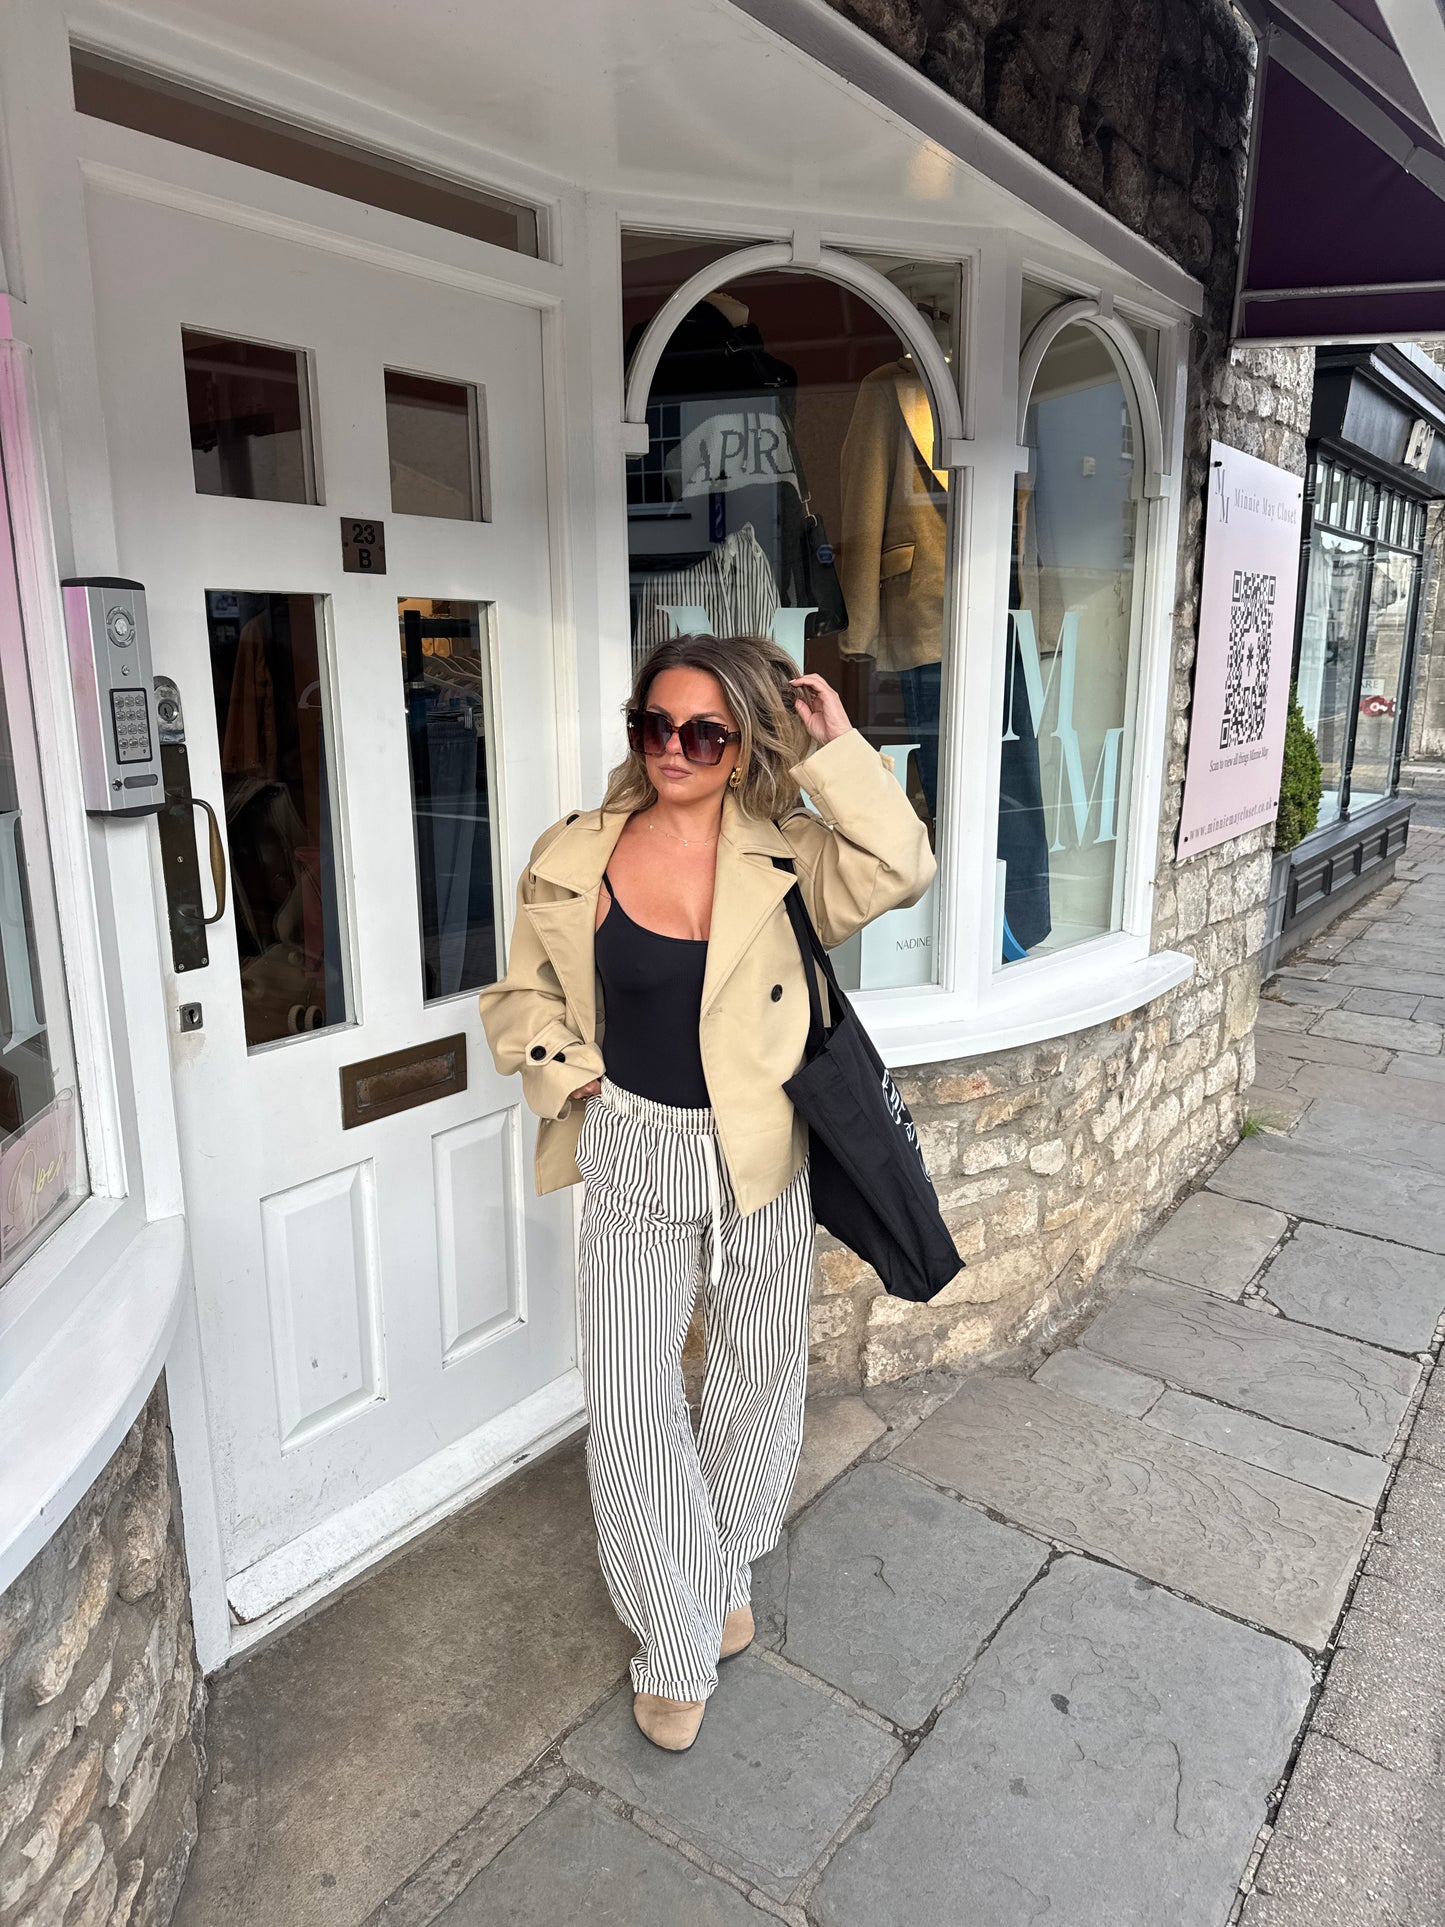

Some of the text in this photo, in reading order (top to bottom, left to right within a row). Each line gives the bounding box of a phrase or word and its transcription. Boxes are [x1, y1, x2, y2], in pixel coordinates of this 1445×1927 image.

[1234, 488, 1297, 525] Minnie May Closet
[352, 523, 376, 545] 23
[359, 549, 372, 568] B
[1190, 797, 1272, 840] www.minniemaycloset.co.uk
[896, 936, 932, 951] NADINE
[7, 1143, 72, 1226] Open
